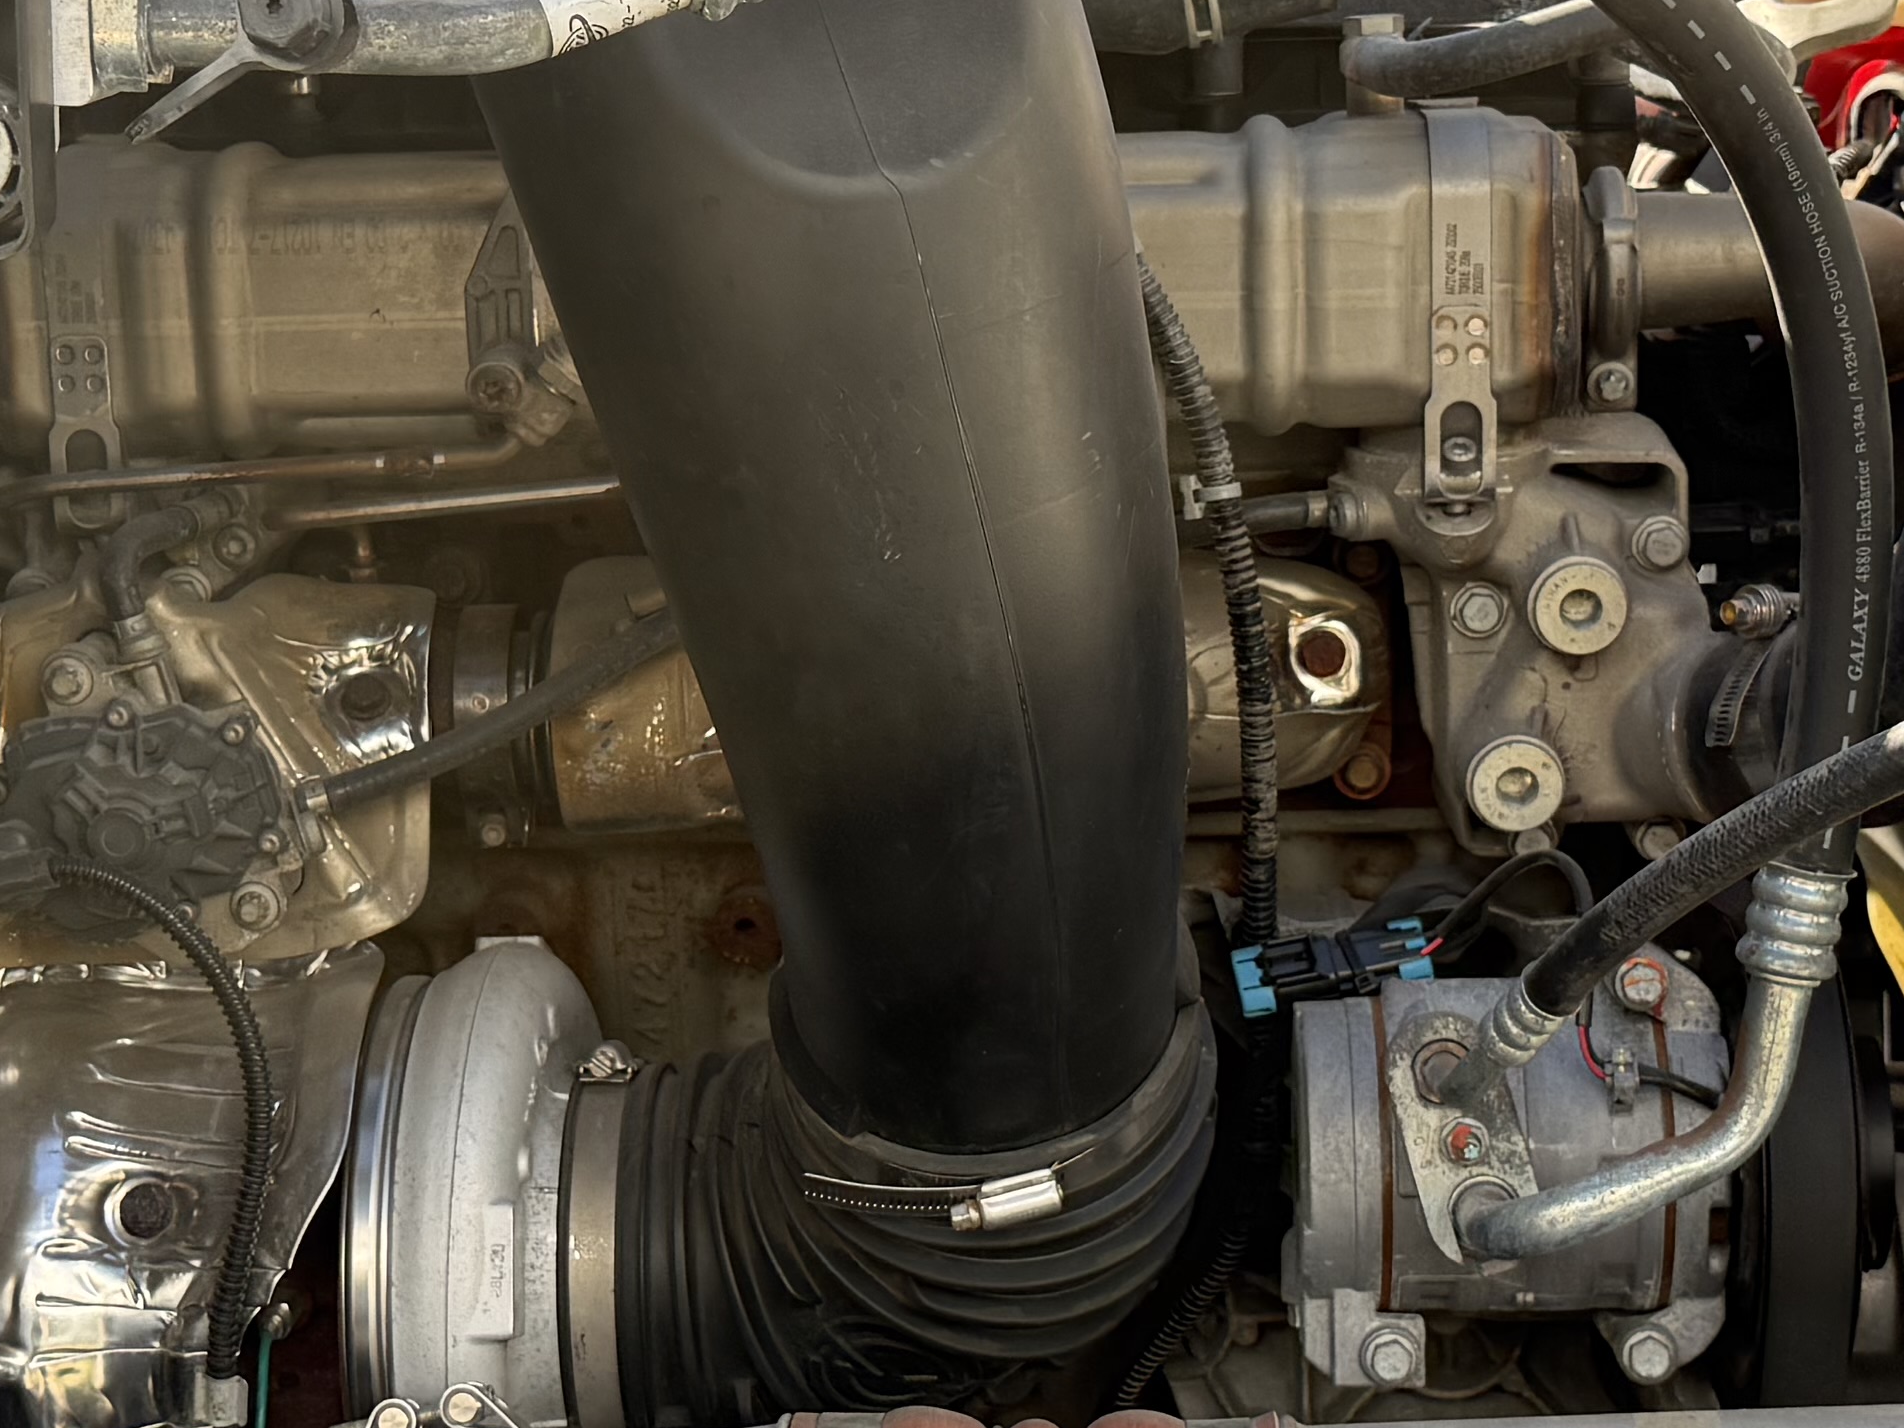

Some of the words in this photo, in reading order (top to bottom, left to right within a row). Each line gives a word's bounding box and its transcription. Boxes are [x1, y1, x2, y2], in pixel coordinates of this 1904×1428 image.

[1756, 107, 1769, 125] in
[1761, 119, 1782, 146] 3/4
[1775, 142, 1808, 193] (19mm)
[1798, 192, 1823, 235] HOSE
[1814, 236, 1844, 301] SUCTION
[1833, 303, 1850, 329] A/C
[1842, 329, 1862, 393] R-1234yf
[1852, 402, 1870, 454] R-134a
[1855, 459, 1872, 543] FlexBarrier
[1855, 545, 1872, 583] 4880
[1847, 588, 1870, 682] GALAXY
